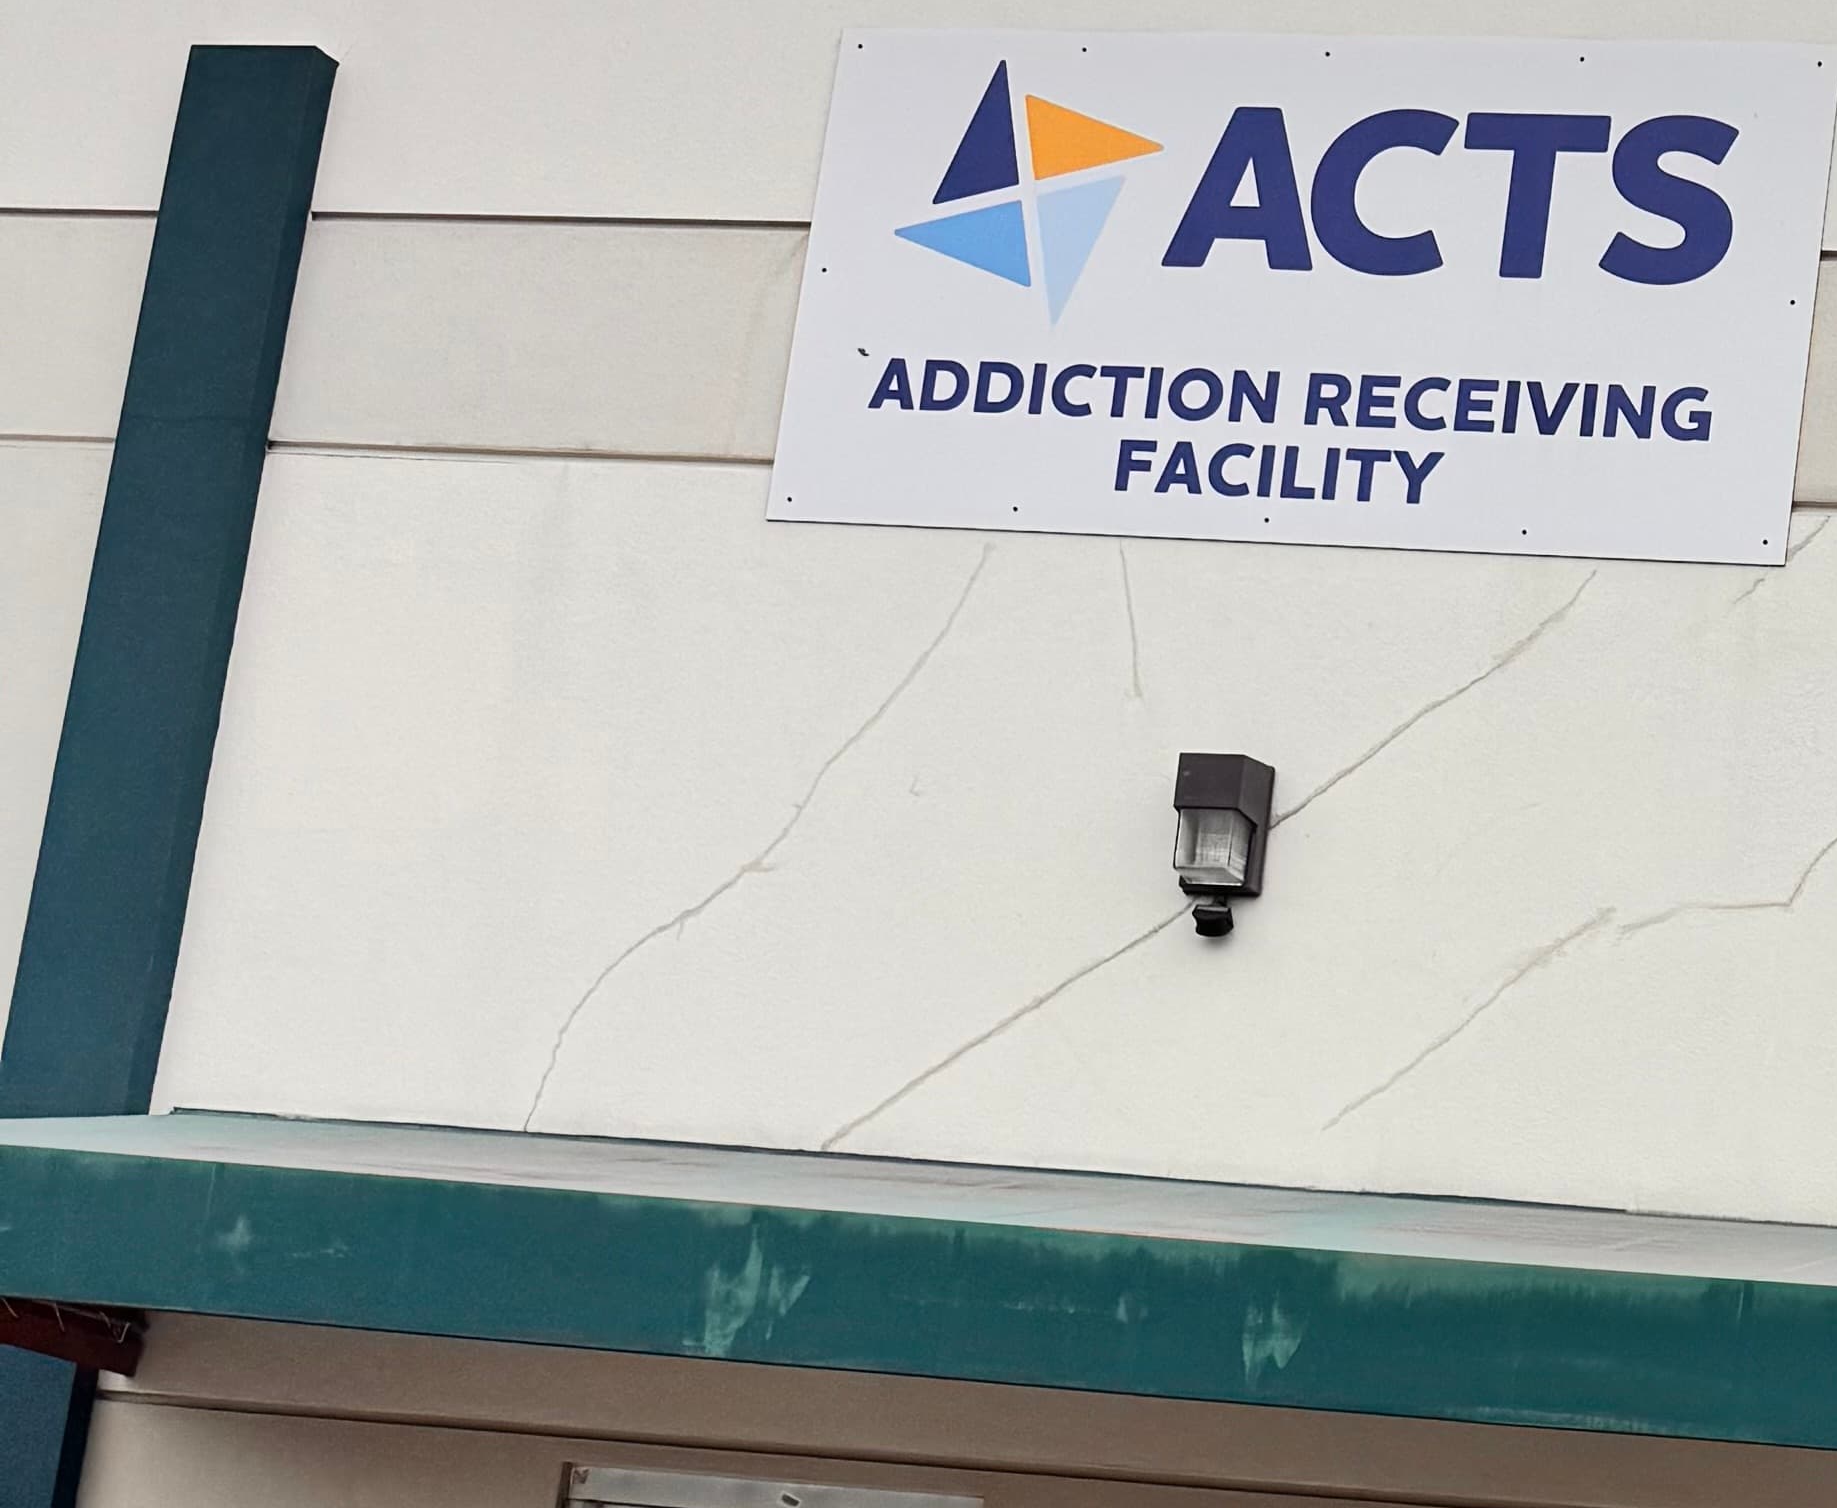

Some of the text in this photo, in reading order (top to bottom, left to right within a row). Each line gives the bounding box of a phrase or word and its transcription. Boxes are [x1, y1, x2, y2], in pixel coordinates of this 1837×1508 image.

[1161, 105, 1740, 286] ACTS
[868, 358, 1713, 444] ADDICTION RECEIVING
[1112, 439, 1445, 505] FACILITY
